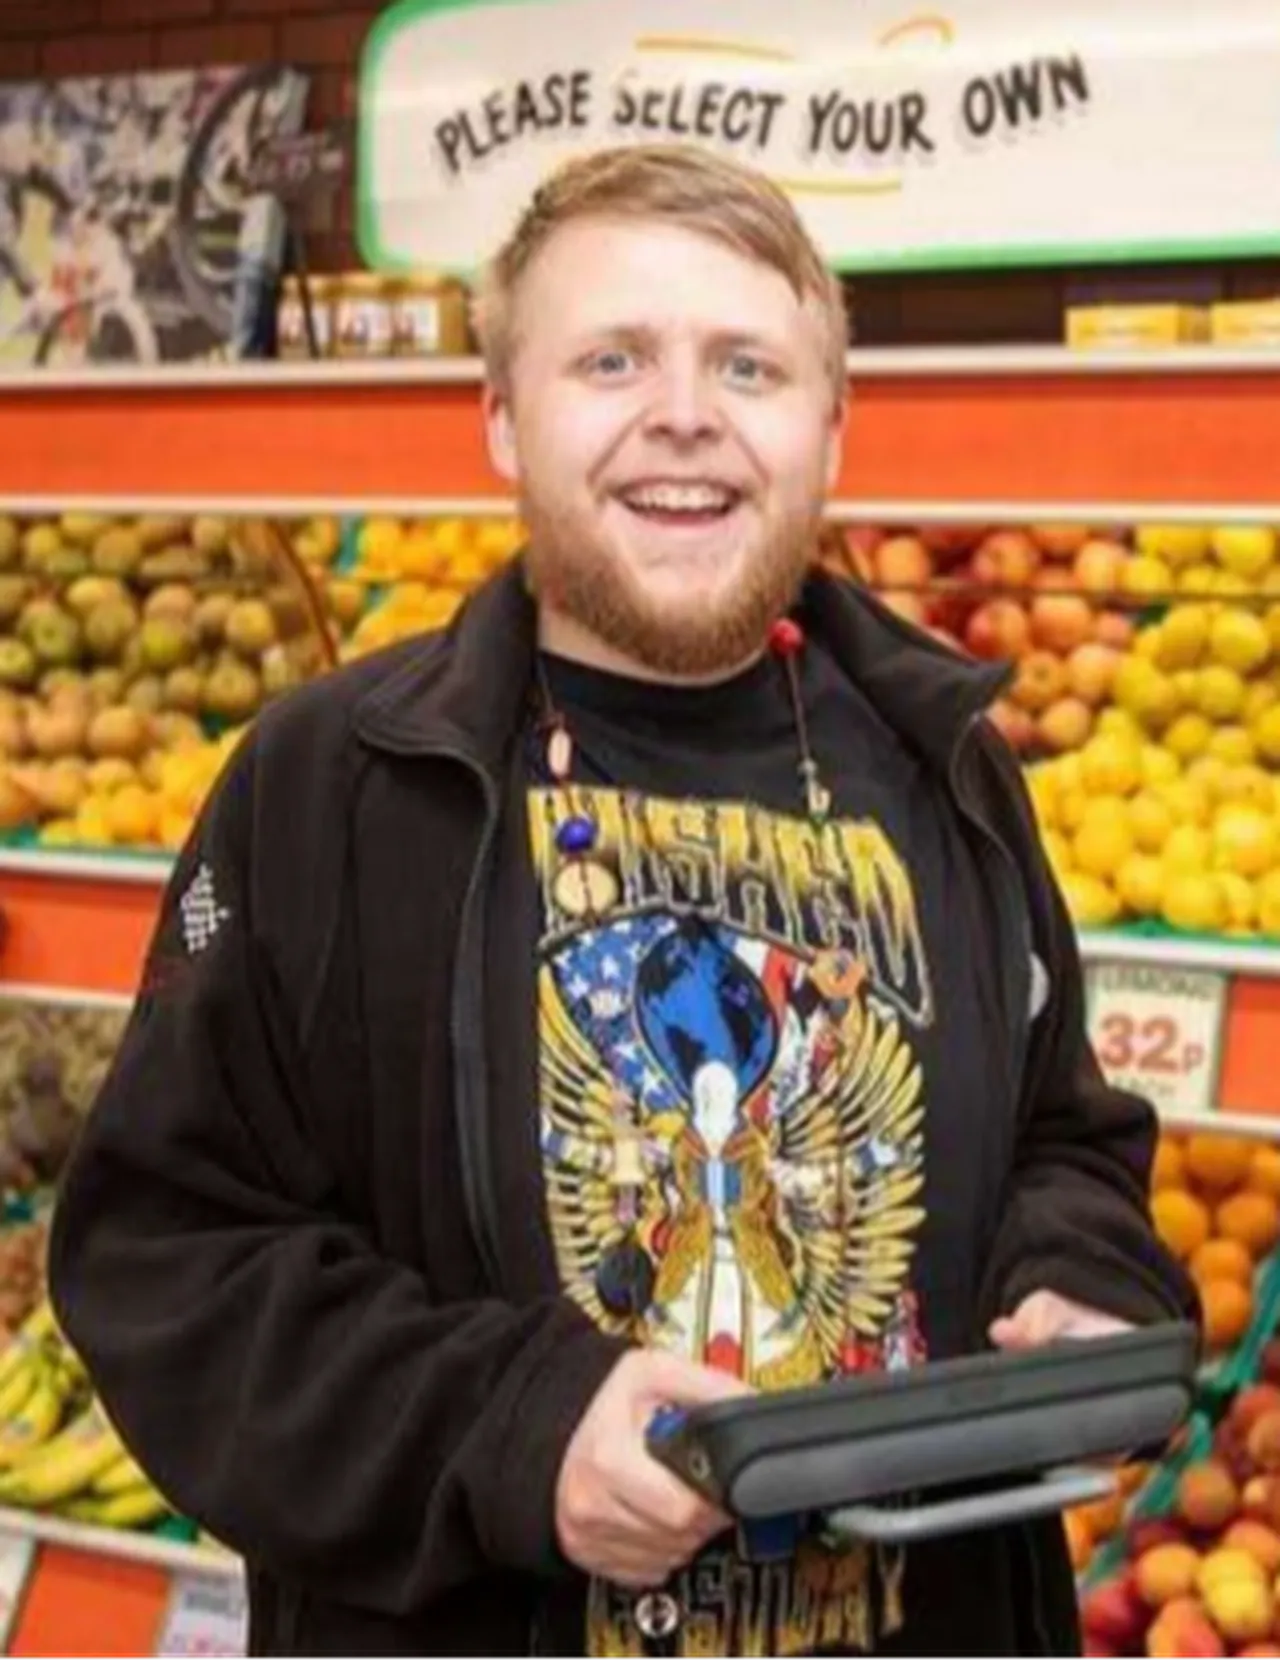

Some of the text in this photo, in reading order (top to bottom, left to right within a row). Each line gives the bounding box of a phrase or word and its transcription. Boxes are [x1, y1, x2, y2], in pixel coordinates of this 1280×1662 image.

[434, 53, 1090, 173] PLEASE SELECT YOUR OWN
[1100, 1012, 1204, 1076] 32p
